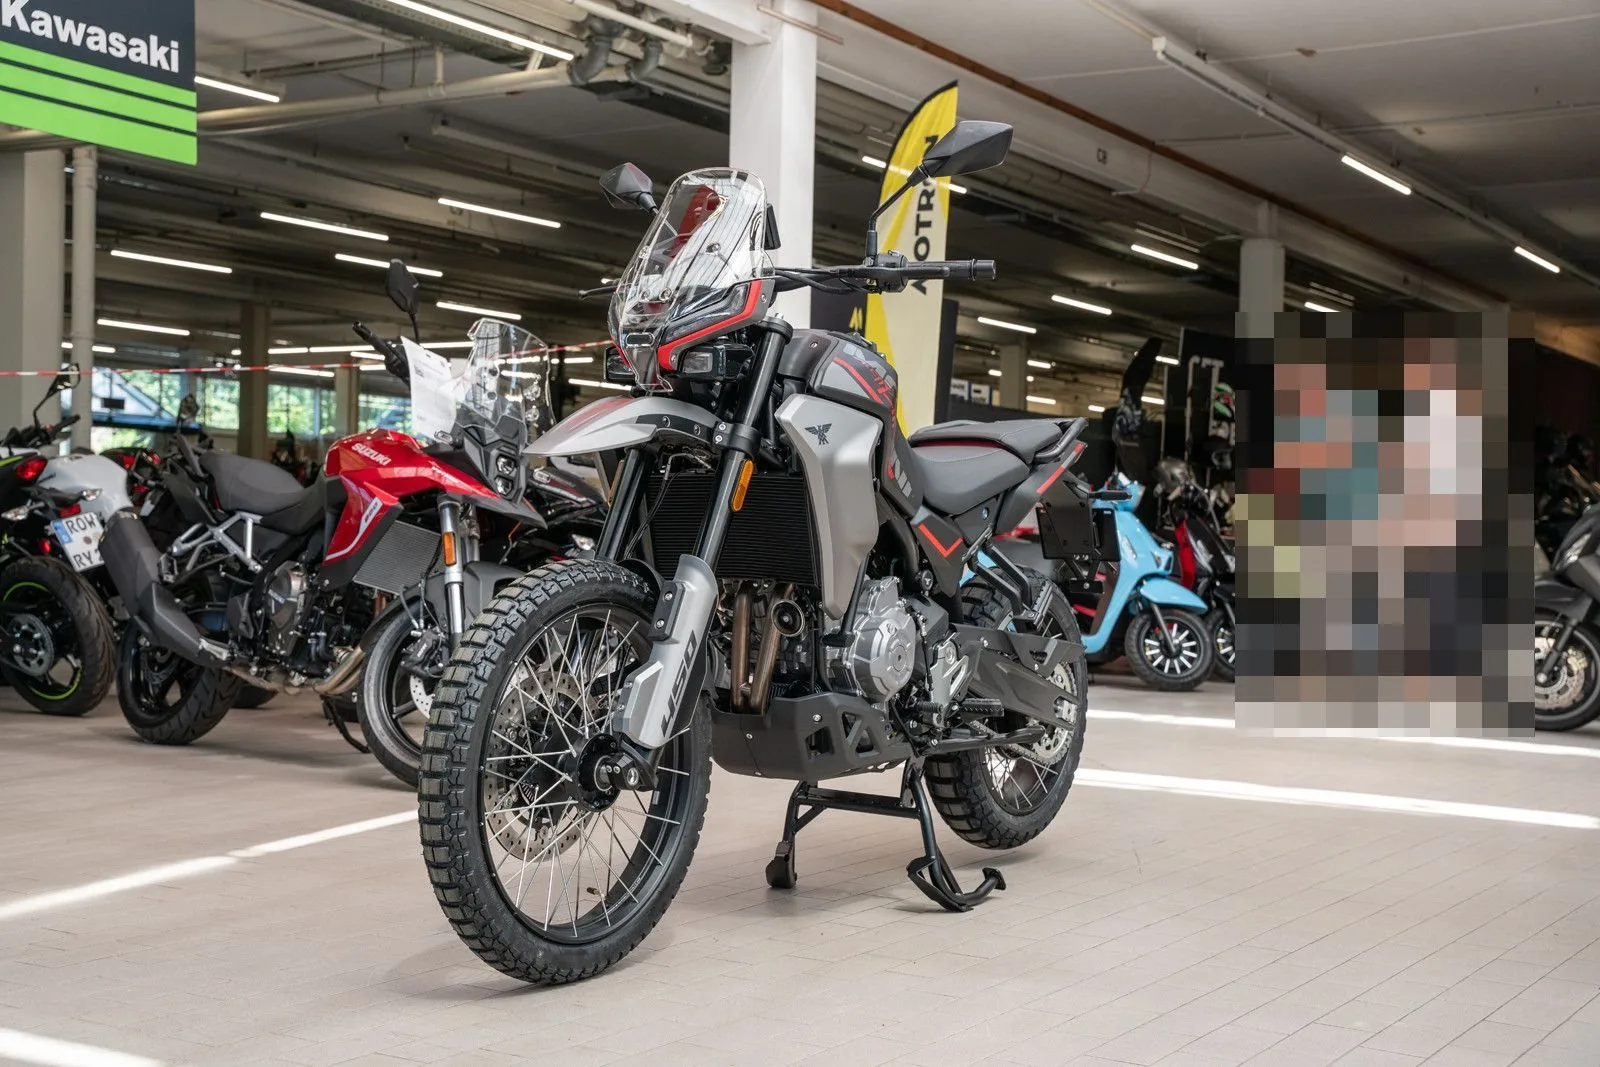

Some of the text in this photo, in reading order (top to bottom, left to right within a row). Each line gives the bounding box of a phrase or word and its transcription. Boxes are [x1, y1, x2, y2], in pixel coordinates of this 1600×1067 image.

[1, 0, 179, 73] Kawasaki
[911, 134, 940, 296] OTRN
[351, 443, 392, 466] SUZUKI
[66, 516, 97, 534] ROW
[660, 629, 698, 738] 450
